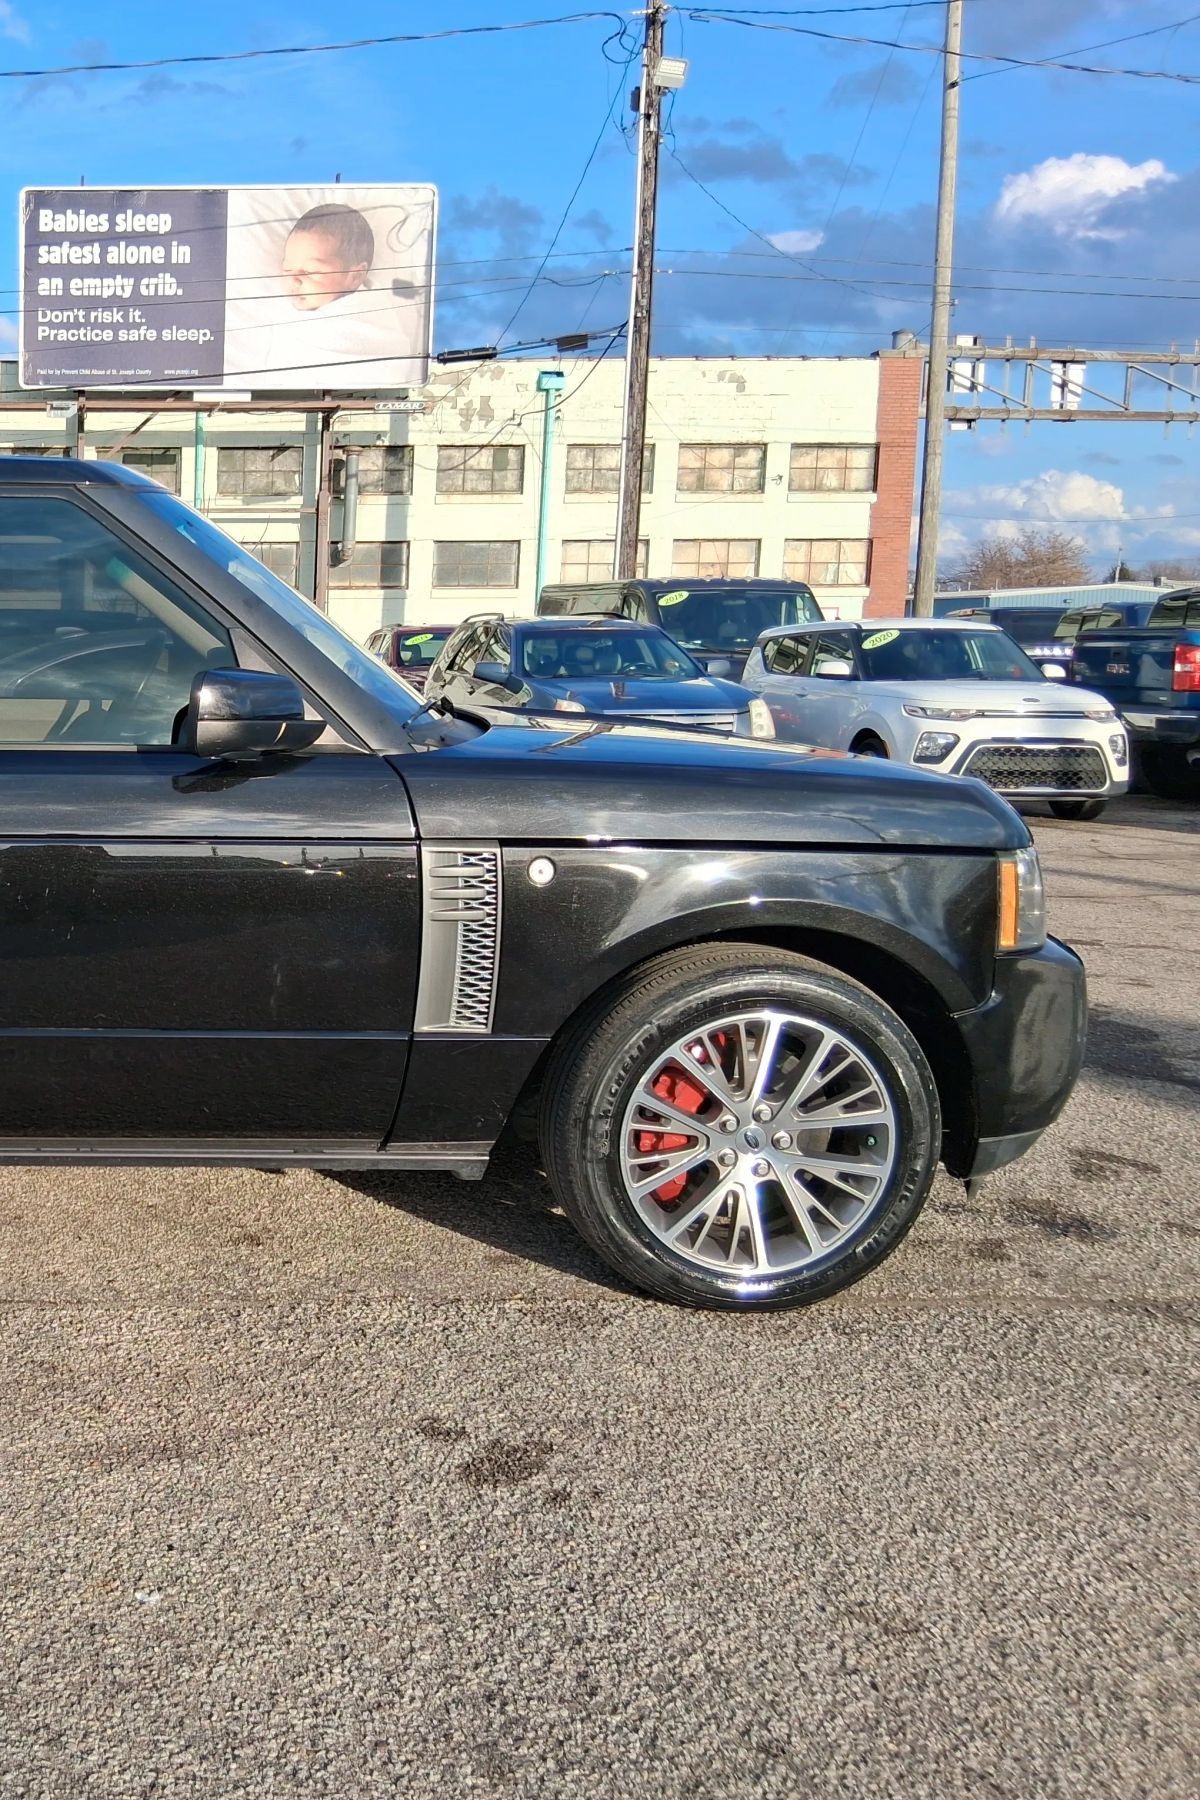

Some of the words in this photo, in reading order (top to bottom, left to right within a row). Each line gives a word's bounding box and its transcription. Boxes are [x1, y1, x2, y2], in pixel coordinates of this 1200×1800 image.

[39, 209, 109, 232] Babies
[115, 209, 172, 234] sleep
[38, 241, 100, 264] safest
[106, 241, 165, 264] alone
[171, 241, 191, 264] in
[37, 277, 63, 296] an
[69, 274, 134, 299] empty
[139, 273, 183, 296] crib.
[37, 308, 85, 323] Don't
[90, 308, 124, 323] risk
[129, 308, 146, 323] it.
[37, 326, 113, 341] Practice
[118, 326, 157, 341] safe
[161, 325, 214, 344] sleep.
[135, 368, 151, 376] County
[377, 401, 425, 410] LAMAR
[869, 631, 893, 647] 2020
